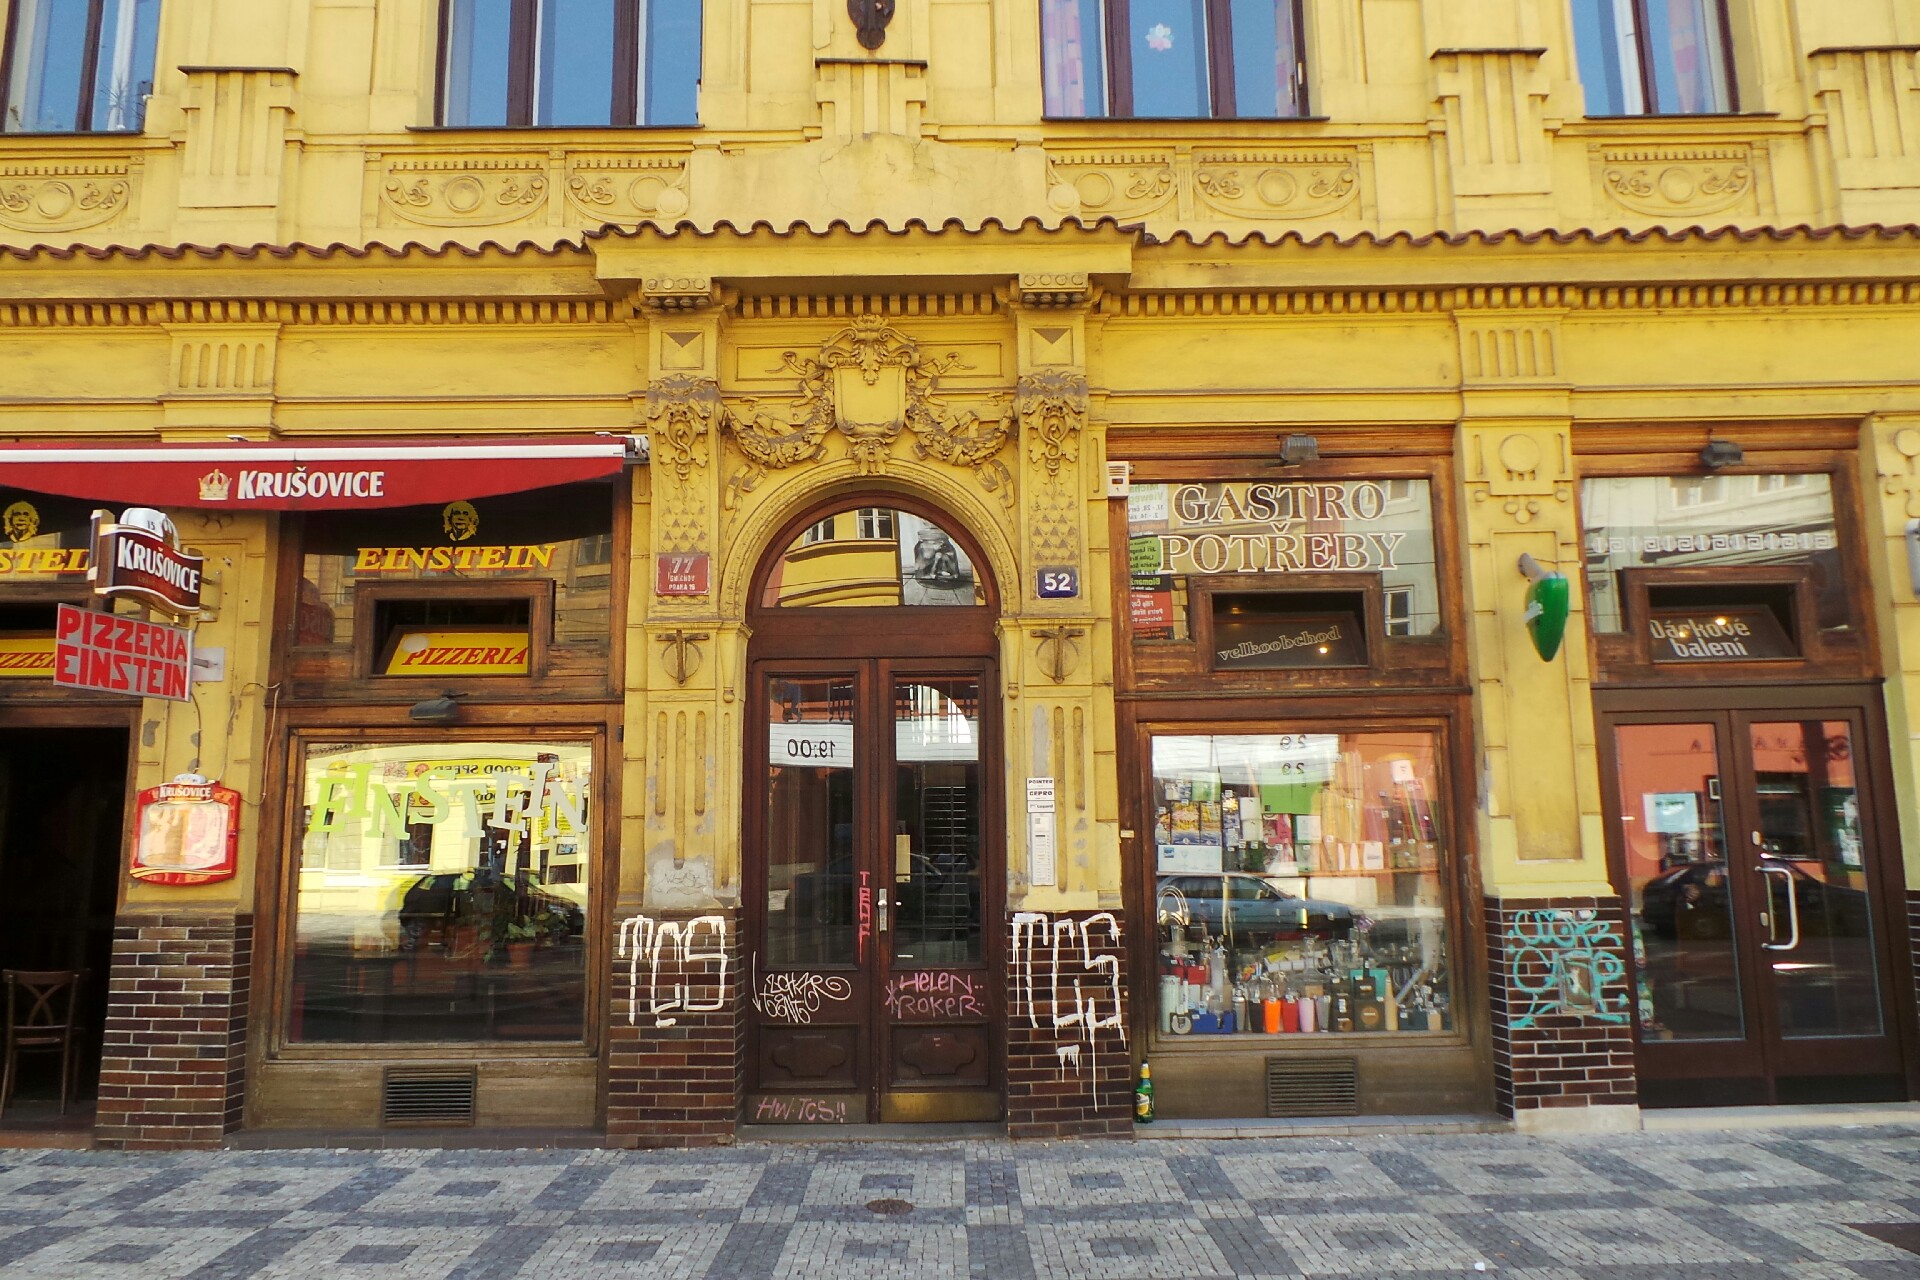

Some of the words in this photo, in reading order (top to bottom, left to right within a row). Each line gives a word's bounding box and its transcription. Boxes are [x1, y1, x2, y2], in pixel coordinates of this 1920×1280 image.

[237, 466, 385, 499] KRUŠOVICE
[1172, 482, 1386, 523] GASTRO
[352, 545, 558, 573] EINSTEIN
[1158, 521, 1406, 574] POTŘEBY
[117, 536, 200, 594] KRUŠOVICE
[671, 557, 695, 574] 77
[1044, 573, 1071, 591] 52
[57, 606, 188, 663] PIZZERIA
[1217, 625, 1342, 661] velkoobchod
[1649, 618, 1751, 639] Dárkové
[401, 647, 529, 666] PIZZERIA
[1668, 637, 1748, 657] balení
[56, 643, 187, 698] EINSTEIN
[160, 785, 211, 798] KRUŠOVICE
[308, 762, 592, 841] EINSTEIN
